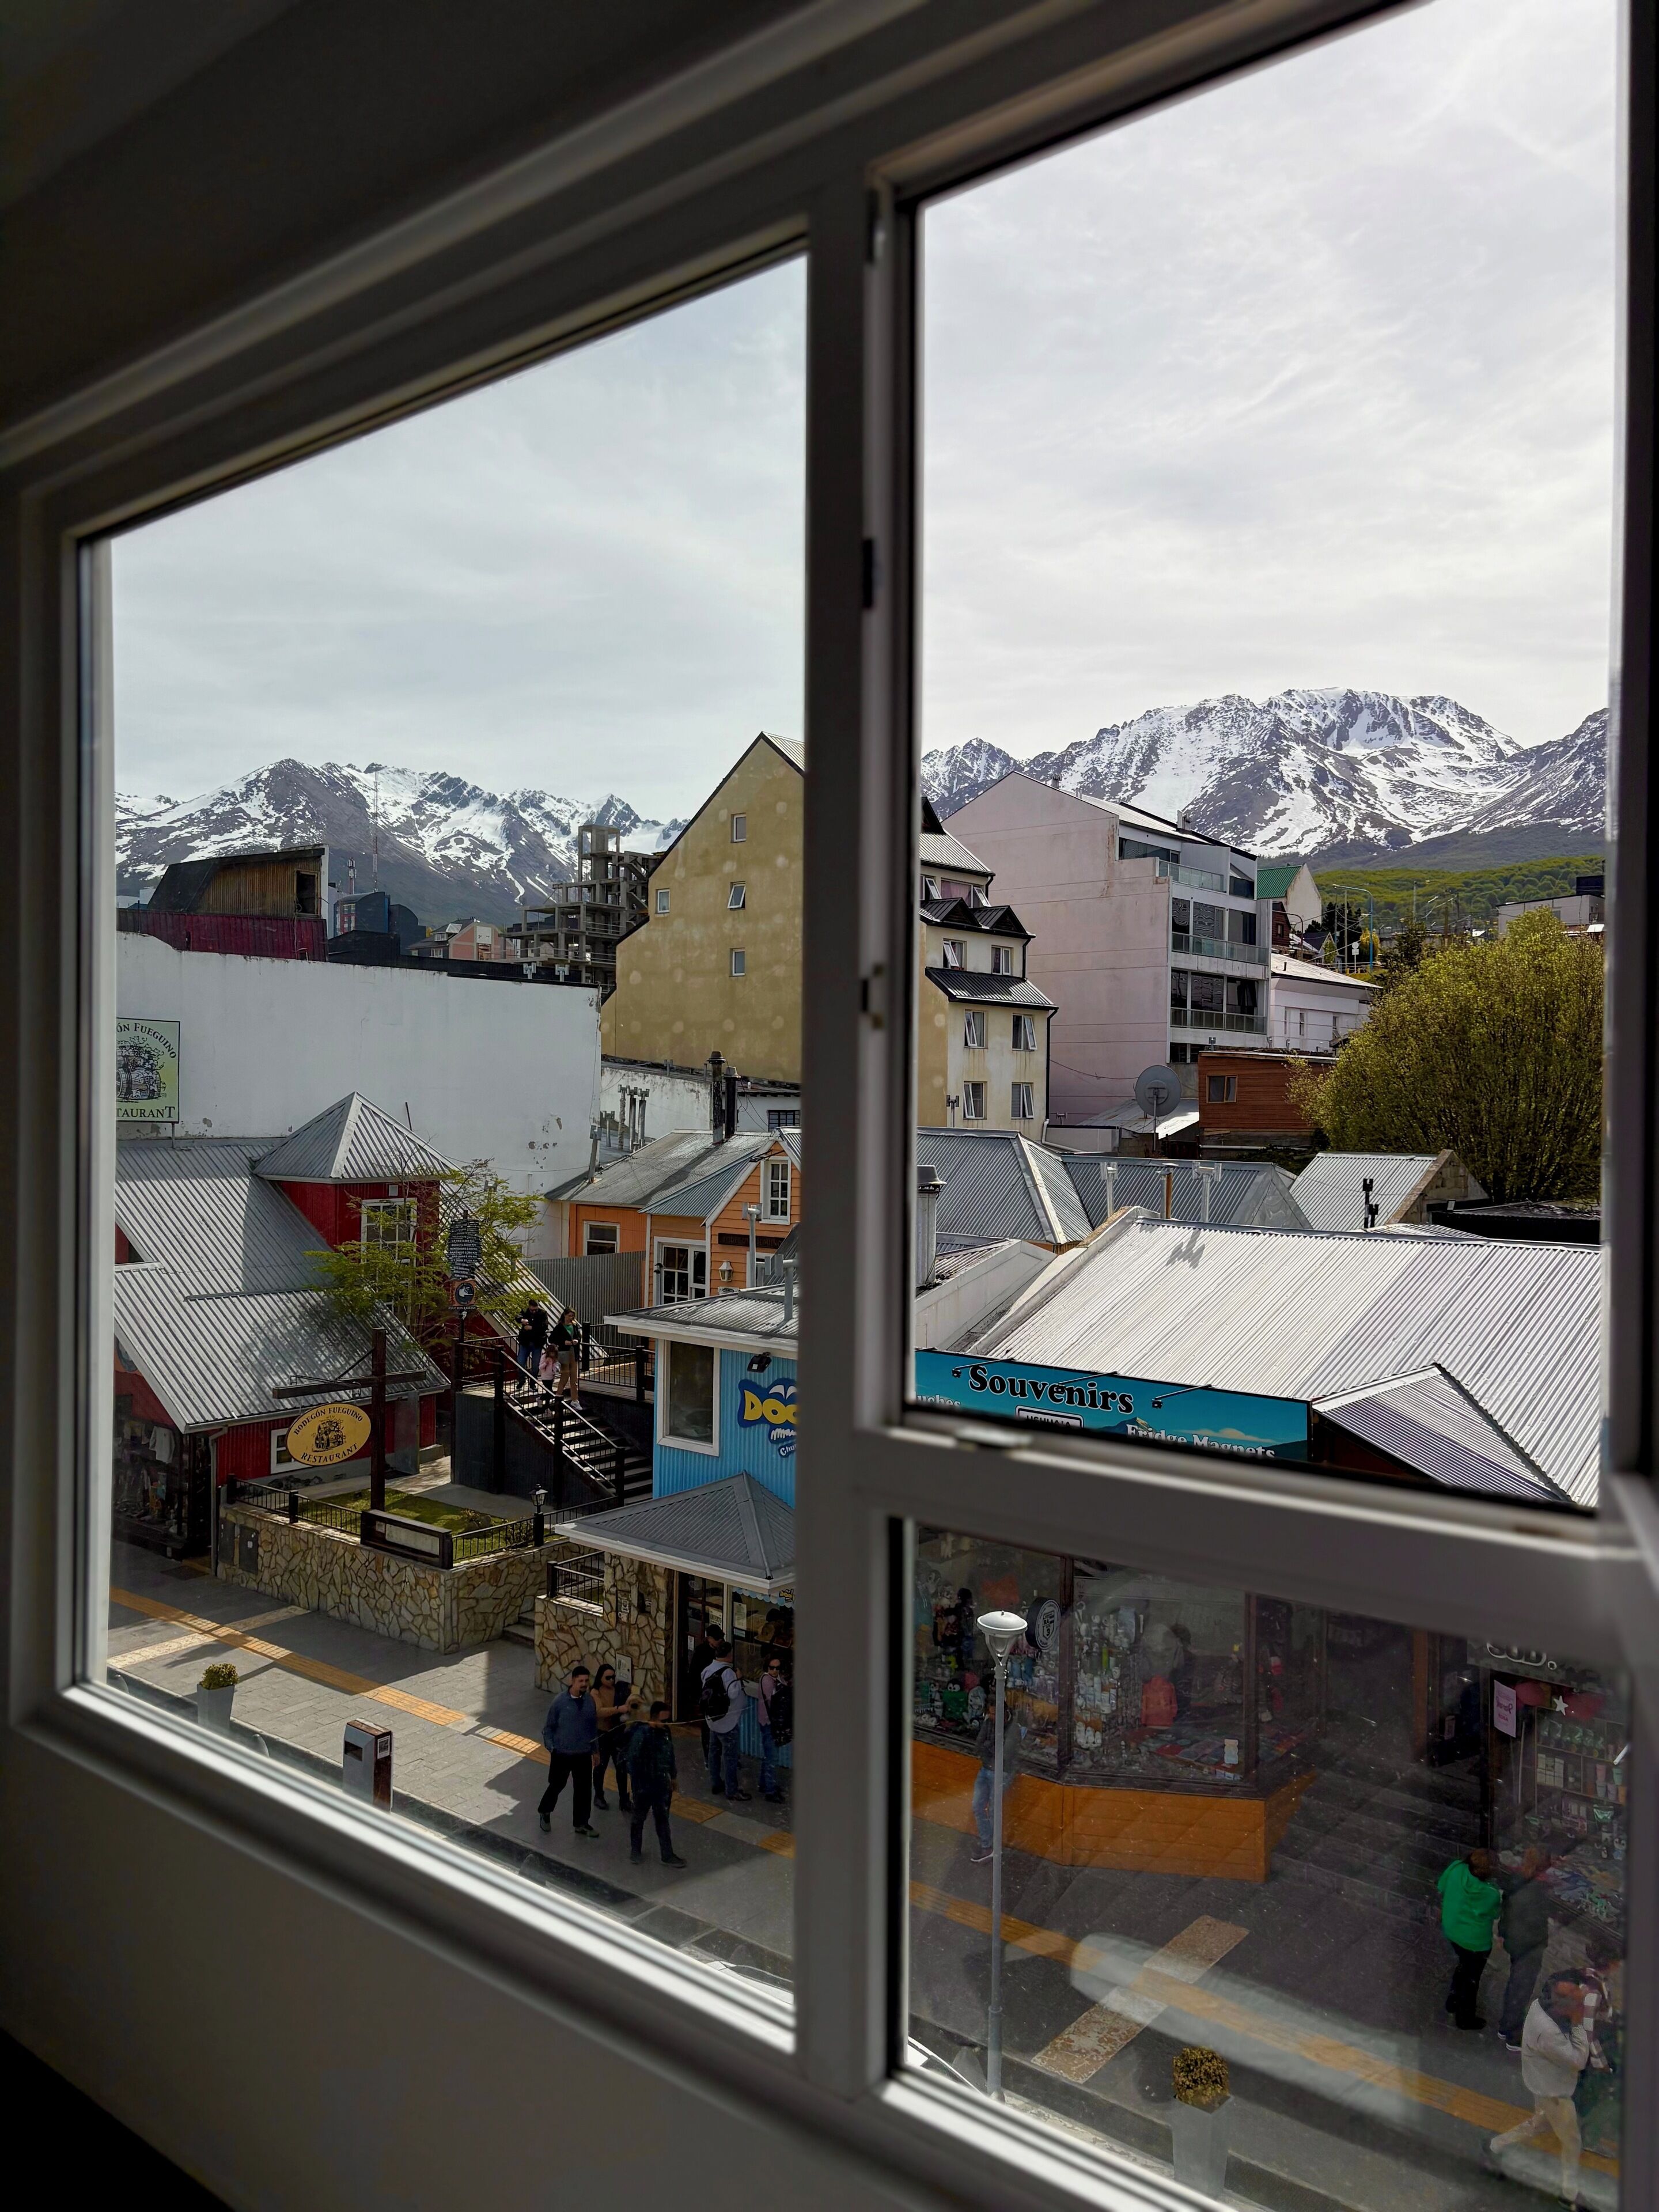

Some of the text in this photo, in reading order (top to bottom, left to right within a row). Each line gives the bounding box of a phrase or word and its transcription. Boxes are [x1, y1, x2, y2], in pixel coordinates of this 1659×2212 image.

[134, 1022, 177, 1059] FUEGUINO
[969, 1365, 1134, 1415] Souvenirs
[328, 1407, 363, 1422] FUEGUINO
[301, 1442, 358, 1463] RESTAURANT
[1126, 1423, 1275, 1459] Fridge Magnets
